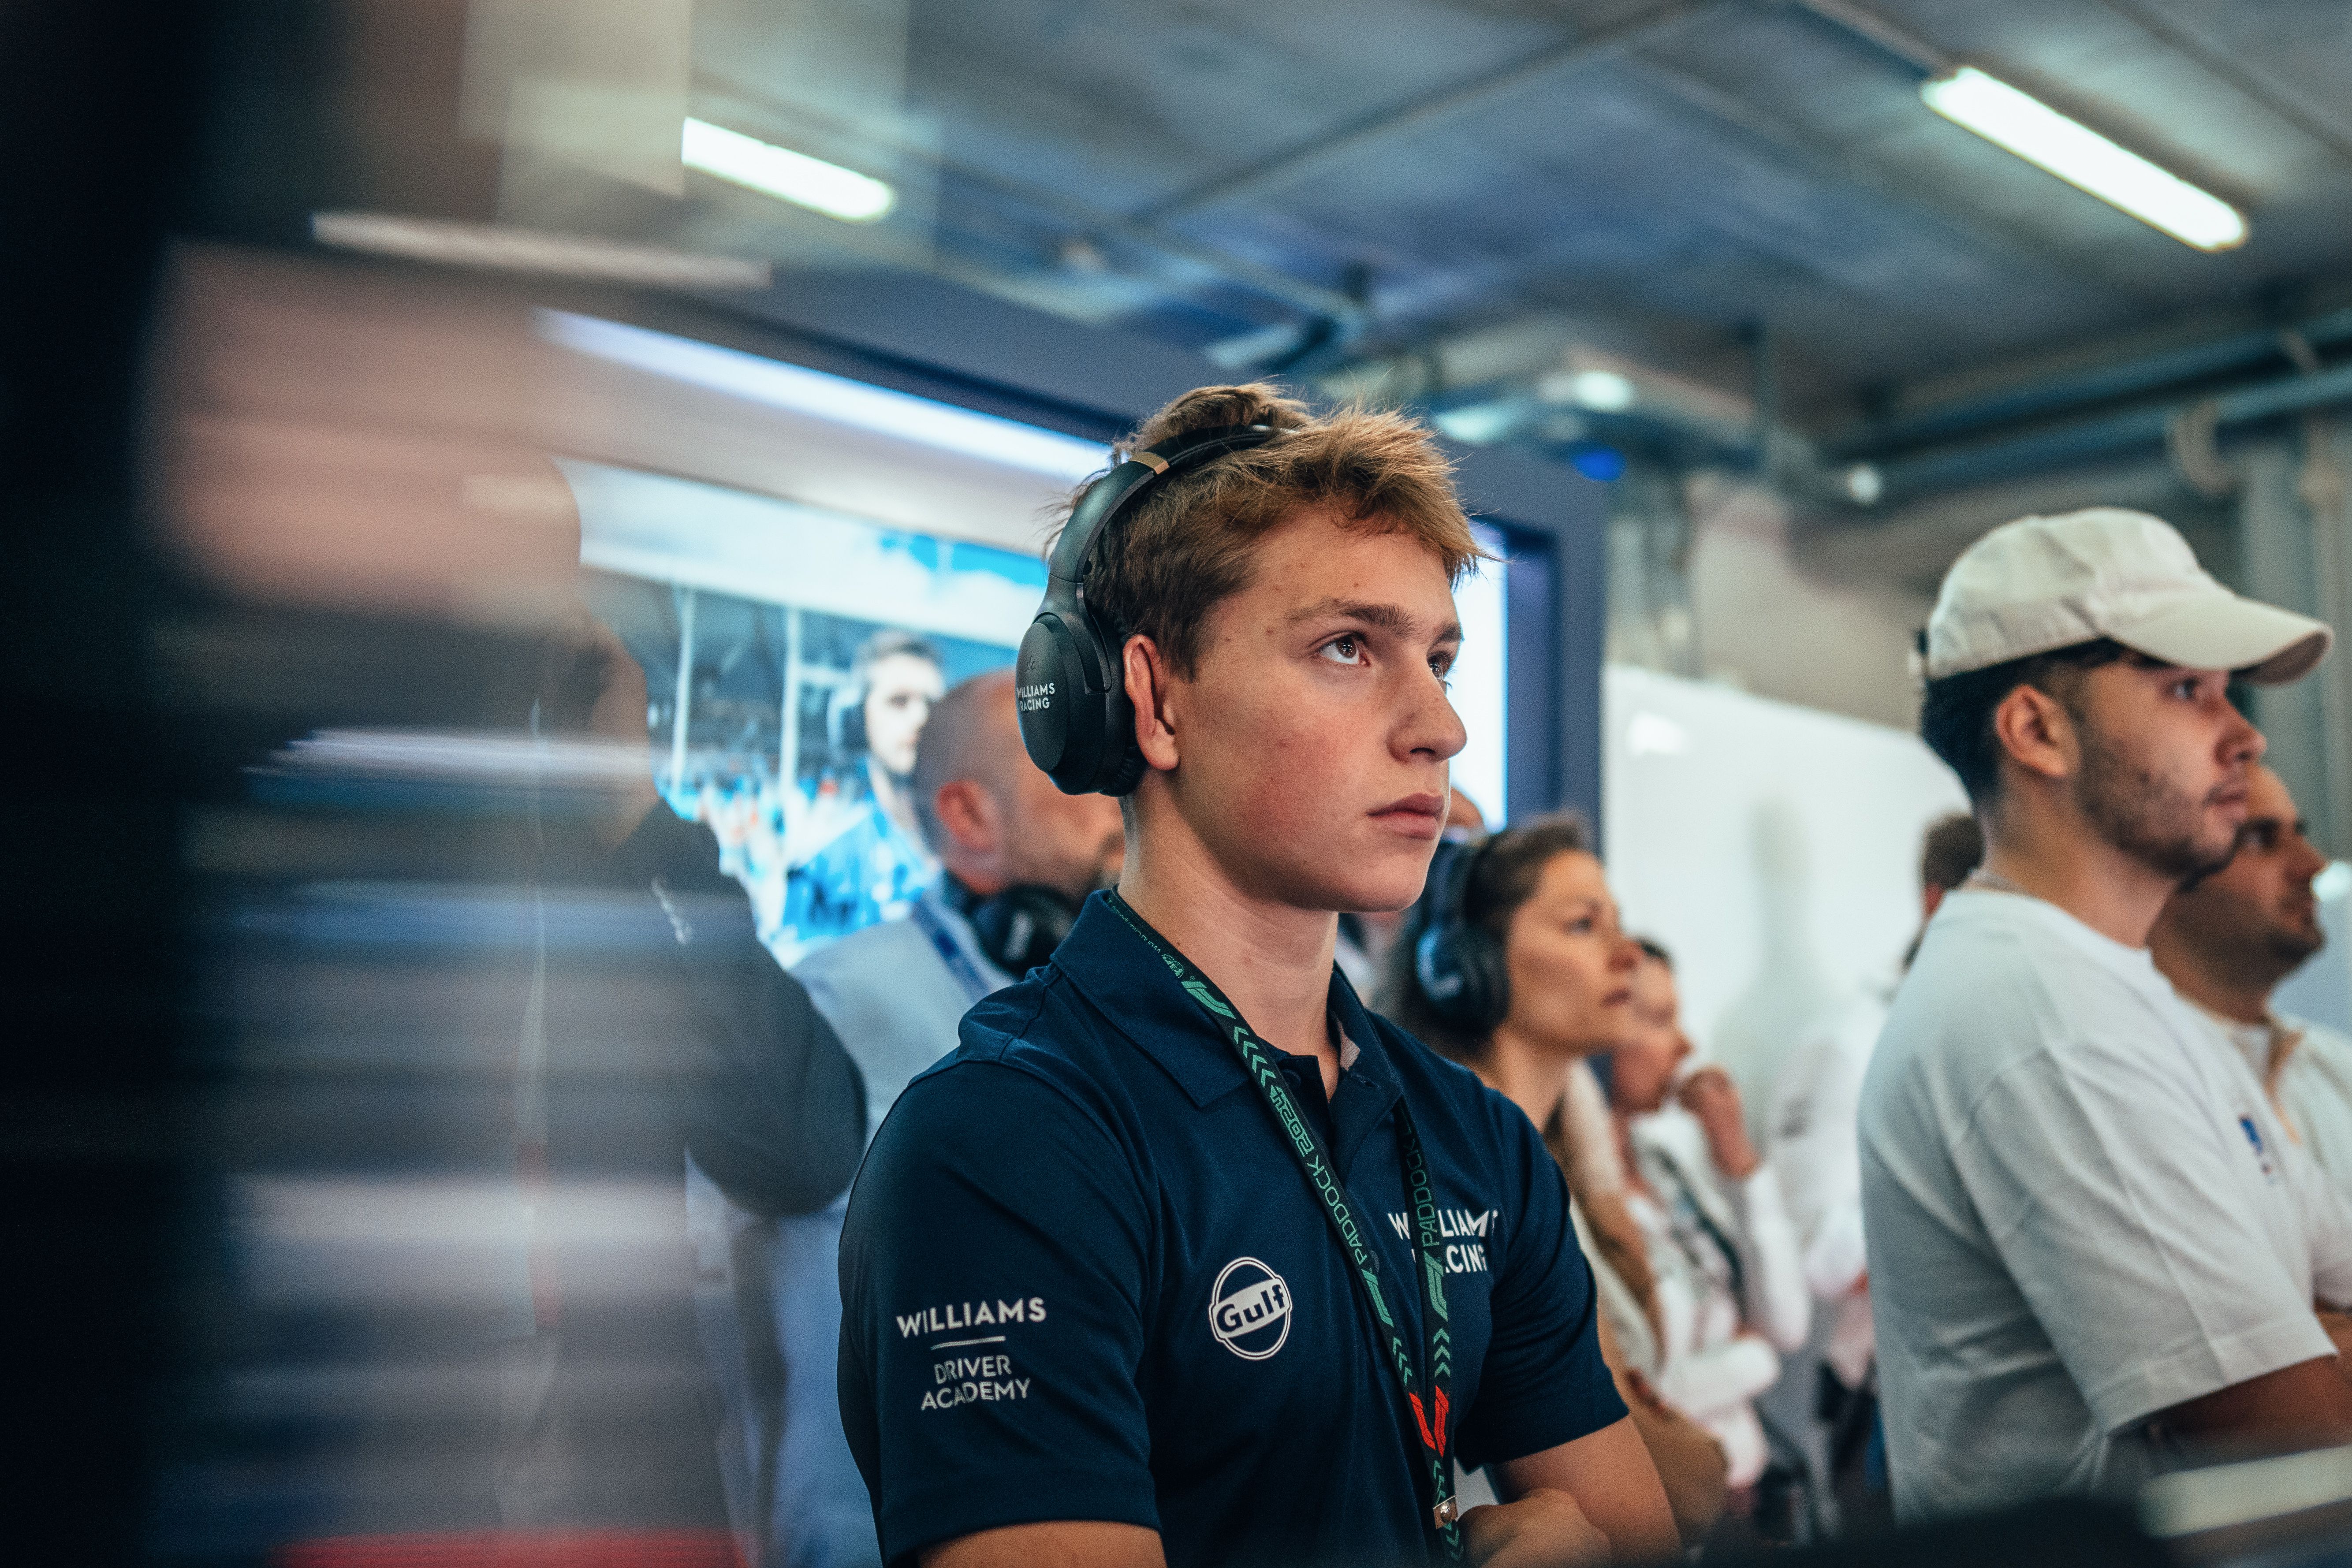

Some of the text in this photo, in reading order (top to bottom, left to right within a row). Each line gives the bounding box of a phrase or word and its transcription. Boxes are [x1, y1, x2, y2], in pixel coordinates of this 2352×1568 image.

[1017, 682, 1055, 699] WILLIAMS
[1020, 697, 1050, 711] RACING
[1270, 1086, 1367, 1265] PADDOCK 2024
[1406, 1137, 1439, 1247] PADDOCK
[1388, 1209, 1498, 1240] WLIAM
[896, 1297, 1046, 1338] WILLIAMS
[1216, 1284, 1285, 1333] Gulf
[934, 1355, 1012, 1384] DRIVER
[921, 1378, 1030, 1411] ACADEMY
